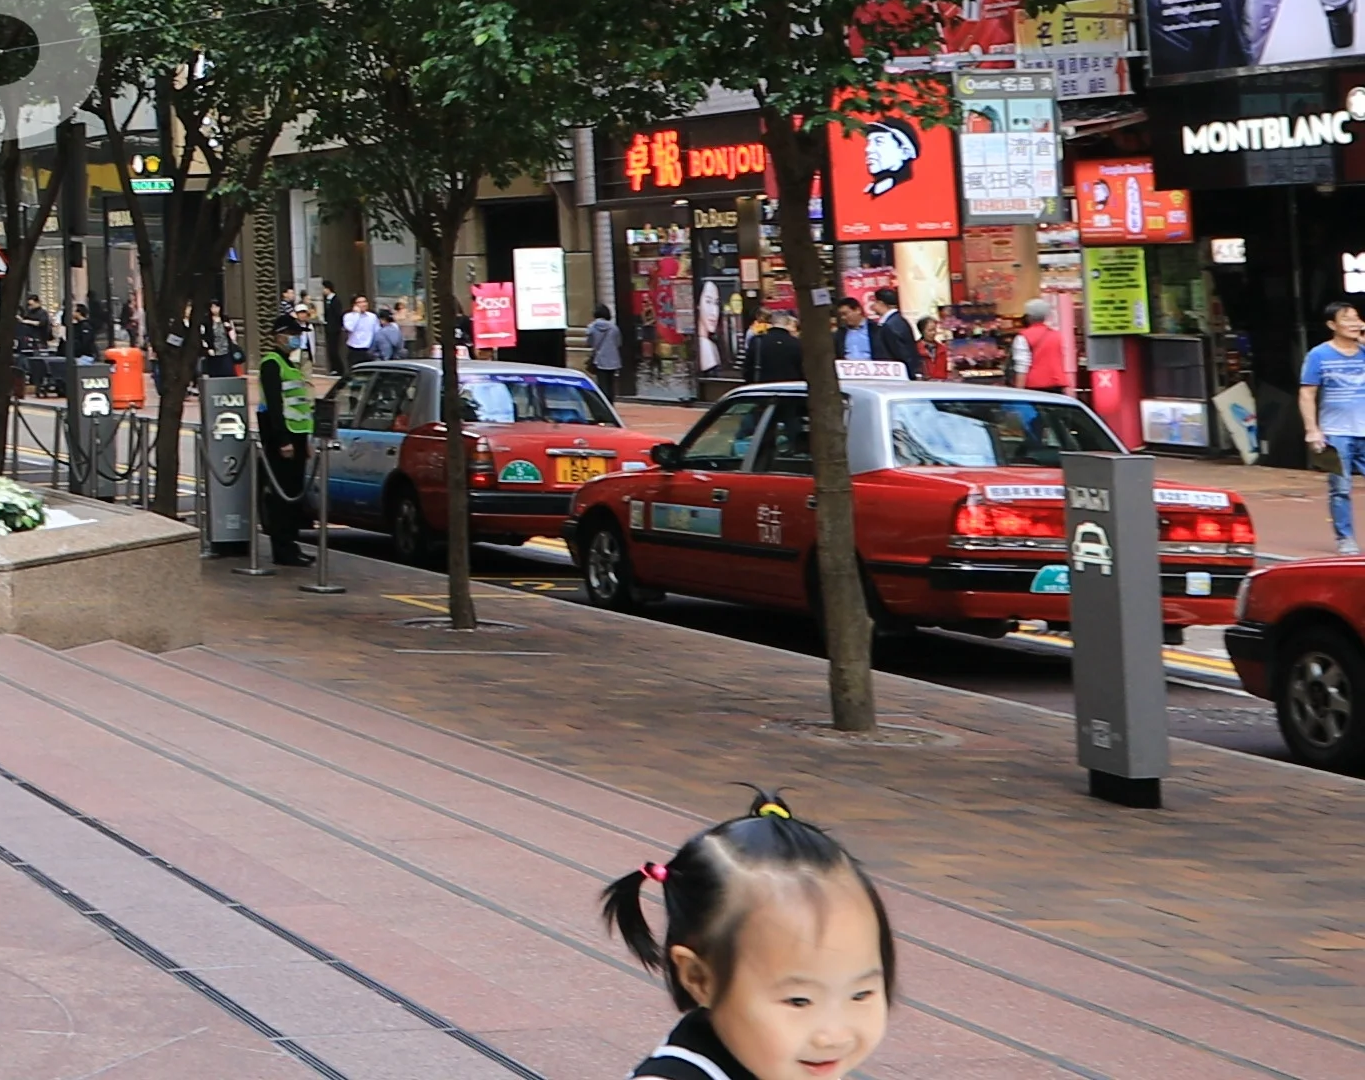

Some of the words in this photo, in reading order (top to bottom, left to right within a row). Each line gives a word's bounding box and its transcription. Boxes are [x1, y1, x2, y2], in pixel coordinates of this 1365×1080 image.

[1182, 110, 1353, 155] MONTBLANC
[840, 362, 901, 377] TAXI
[82, 378, 109, 389] TAXI
[212, 394, 244, 407] TAXI
[222, 456, 238, 478] 2
[1071, 487, 1110, 512] TAXI
